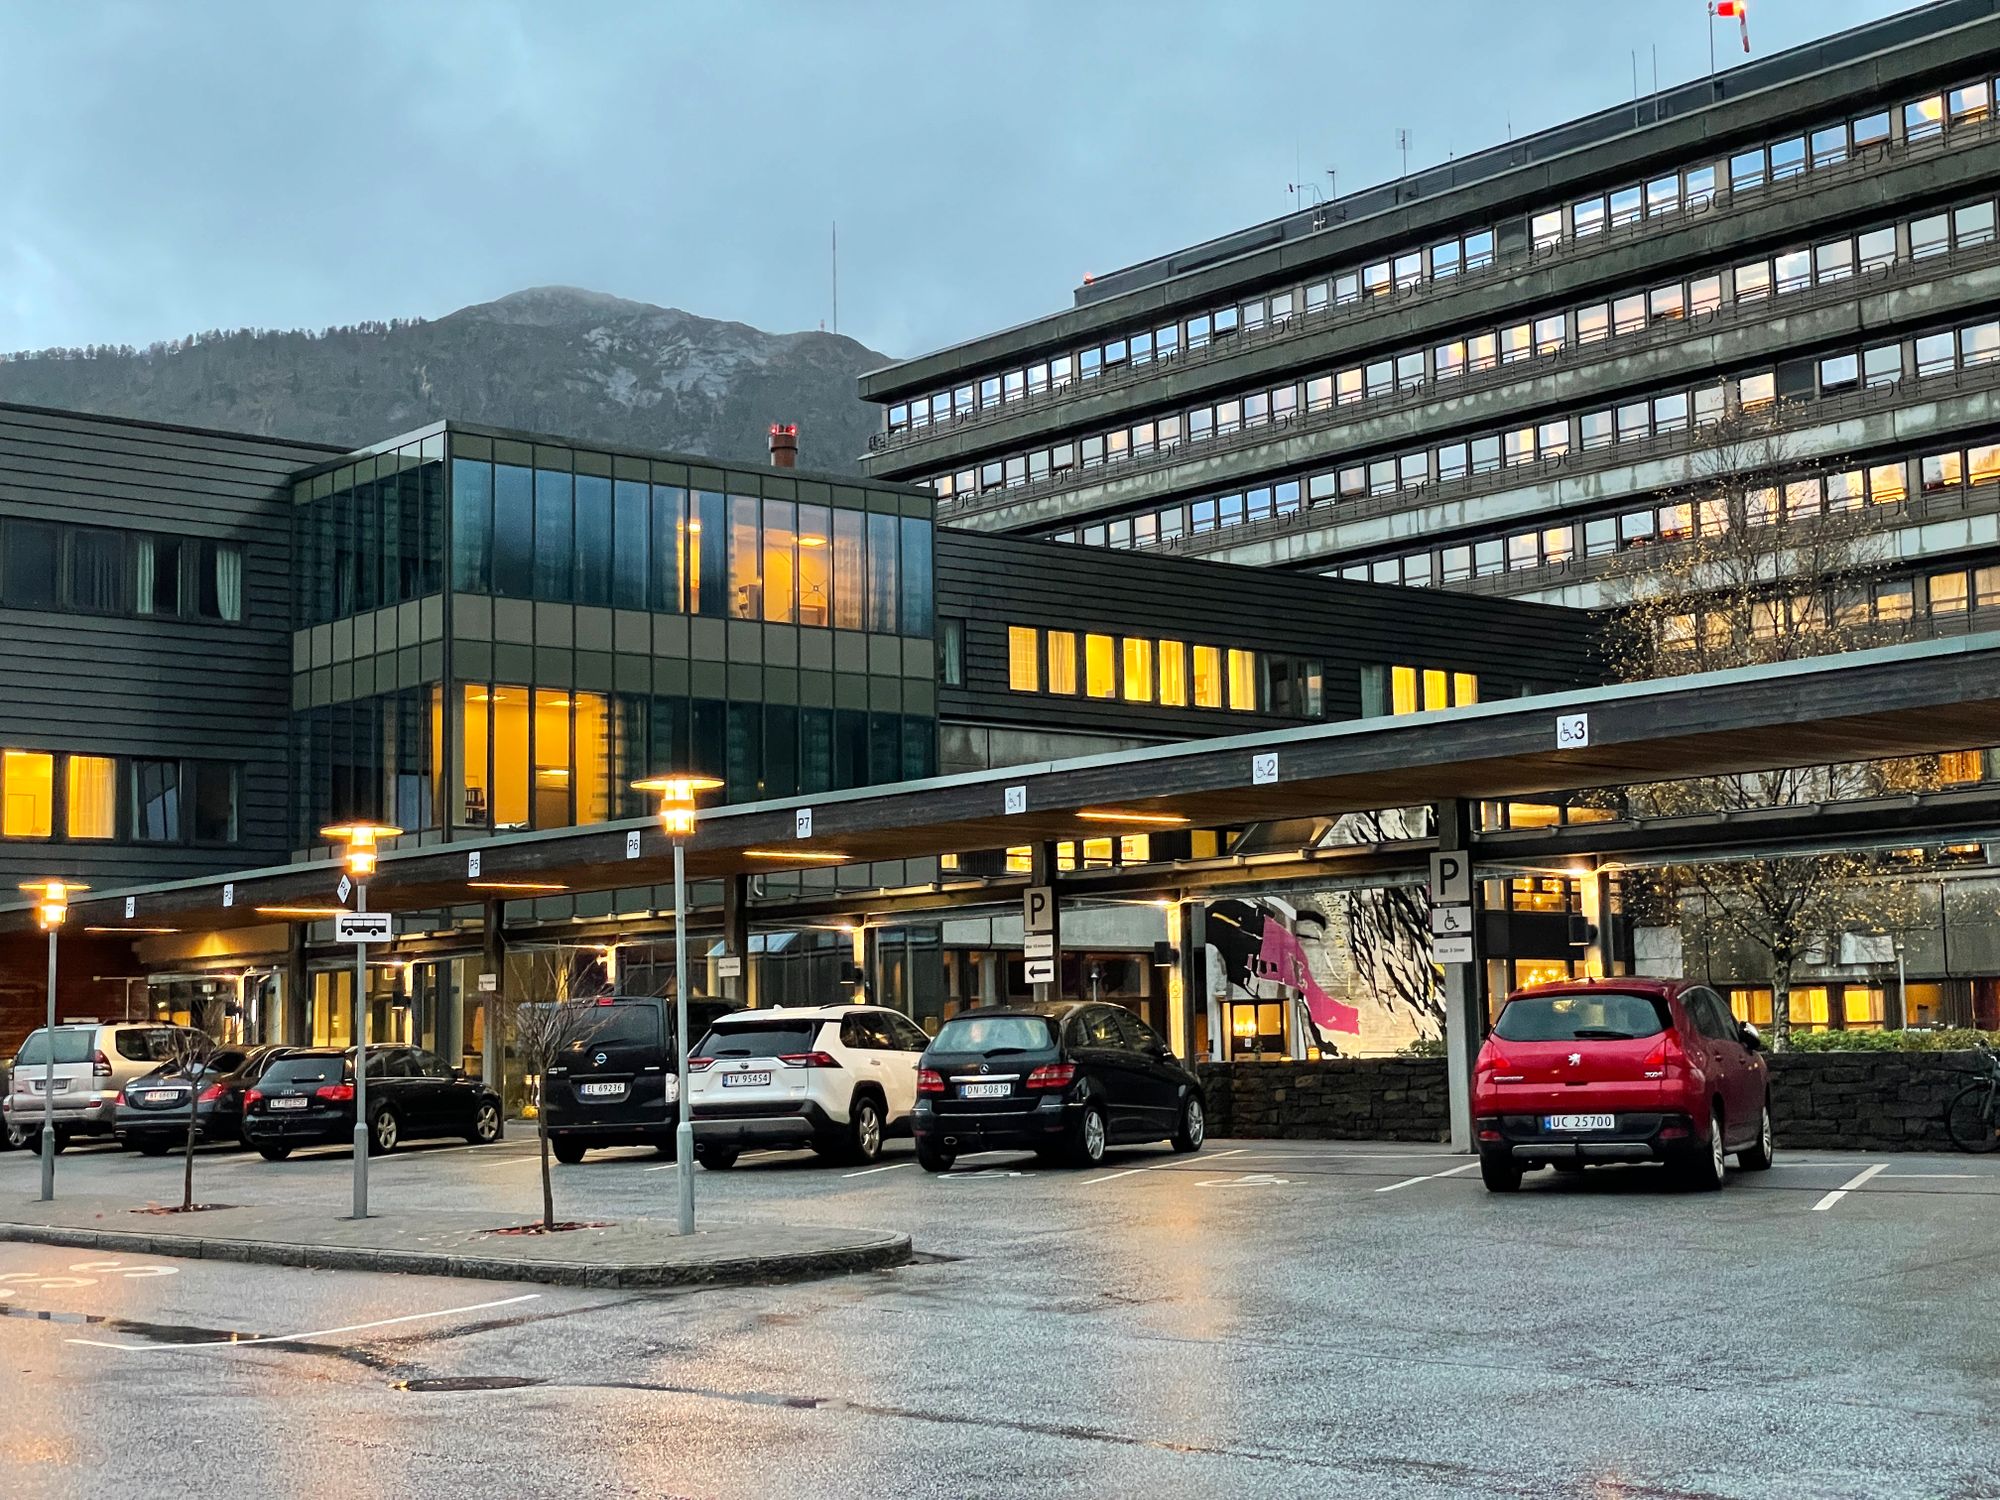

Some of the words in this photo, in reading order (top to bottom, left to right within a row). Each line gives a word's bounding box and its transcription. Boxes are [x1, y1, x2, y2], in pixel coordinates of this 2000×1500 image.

[1573, 720, 1585, 740] 3
[1266, 759, 1276, 777] 2
[1016, 791, 1022, 808] 1
[798, 816, 810, 830] P7
[628, 839, 638, 850] P6
[470, 858, 479, 870] P5
[1439, 857, 1459, 896] P
[1030, 893, 1046, 926] P
[729, 1075, 739, 1083] TV
[742, 1074, 768, 1083] 95454
[586, 1084, 595, 1093] EL
[598, 1084, 622, 1092] 69236
[967, 1085, 979, 1094] DN
[983, 1084, 1009, 1094] 50819
[1552, 1117, 1568, 1127] UC
[1574, 1116, 1612, 1127] 25700
